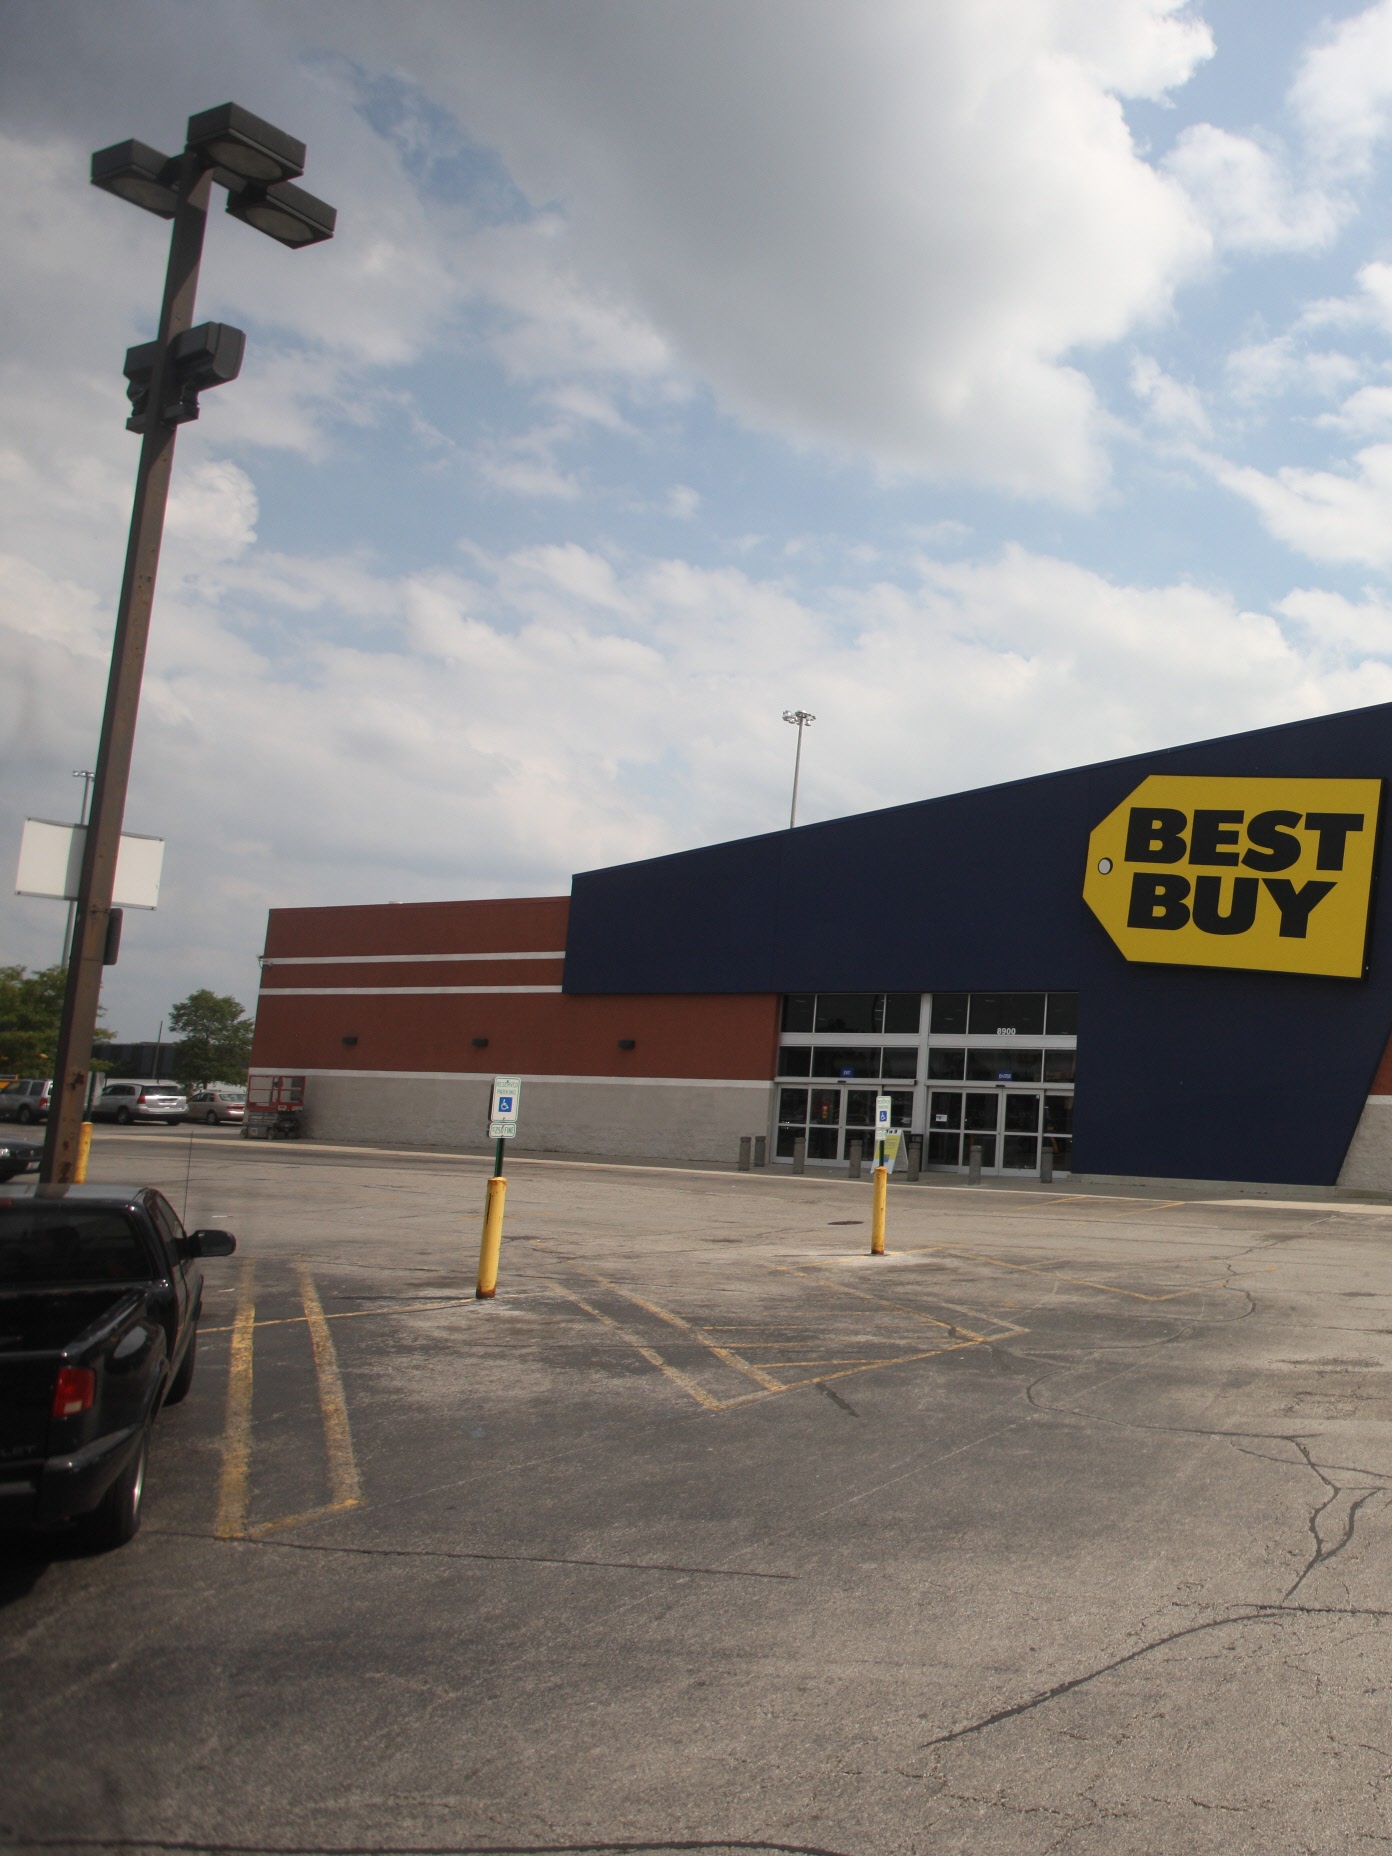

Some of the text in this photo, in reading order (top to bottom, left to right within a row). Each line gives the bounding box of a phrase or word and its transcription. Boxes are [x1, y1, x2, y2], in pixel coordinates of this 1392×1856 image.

[1124, 807, 1364, 872] BEST
[1127, 872, 1338, 938] BUY
[996, 1027, 1016, 1035] 8900
